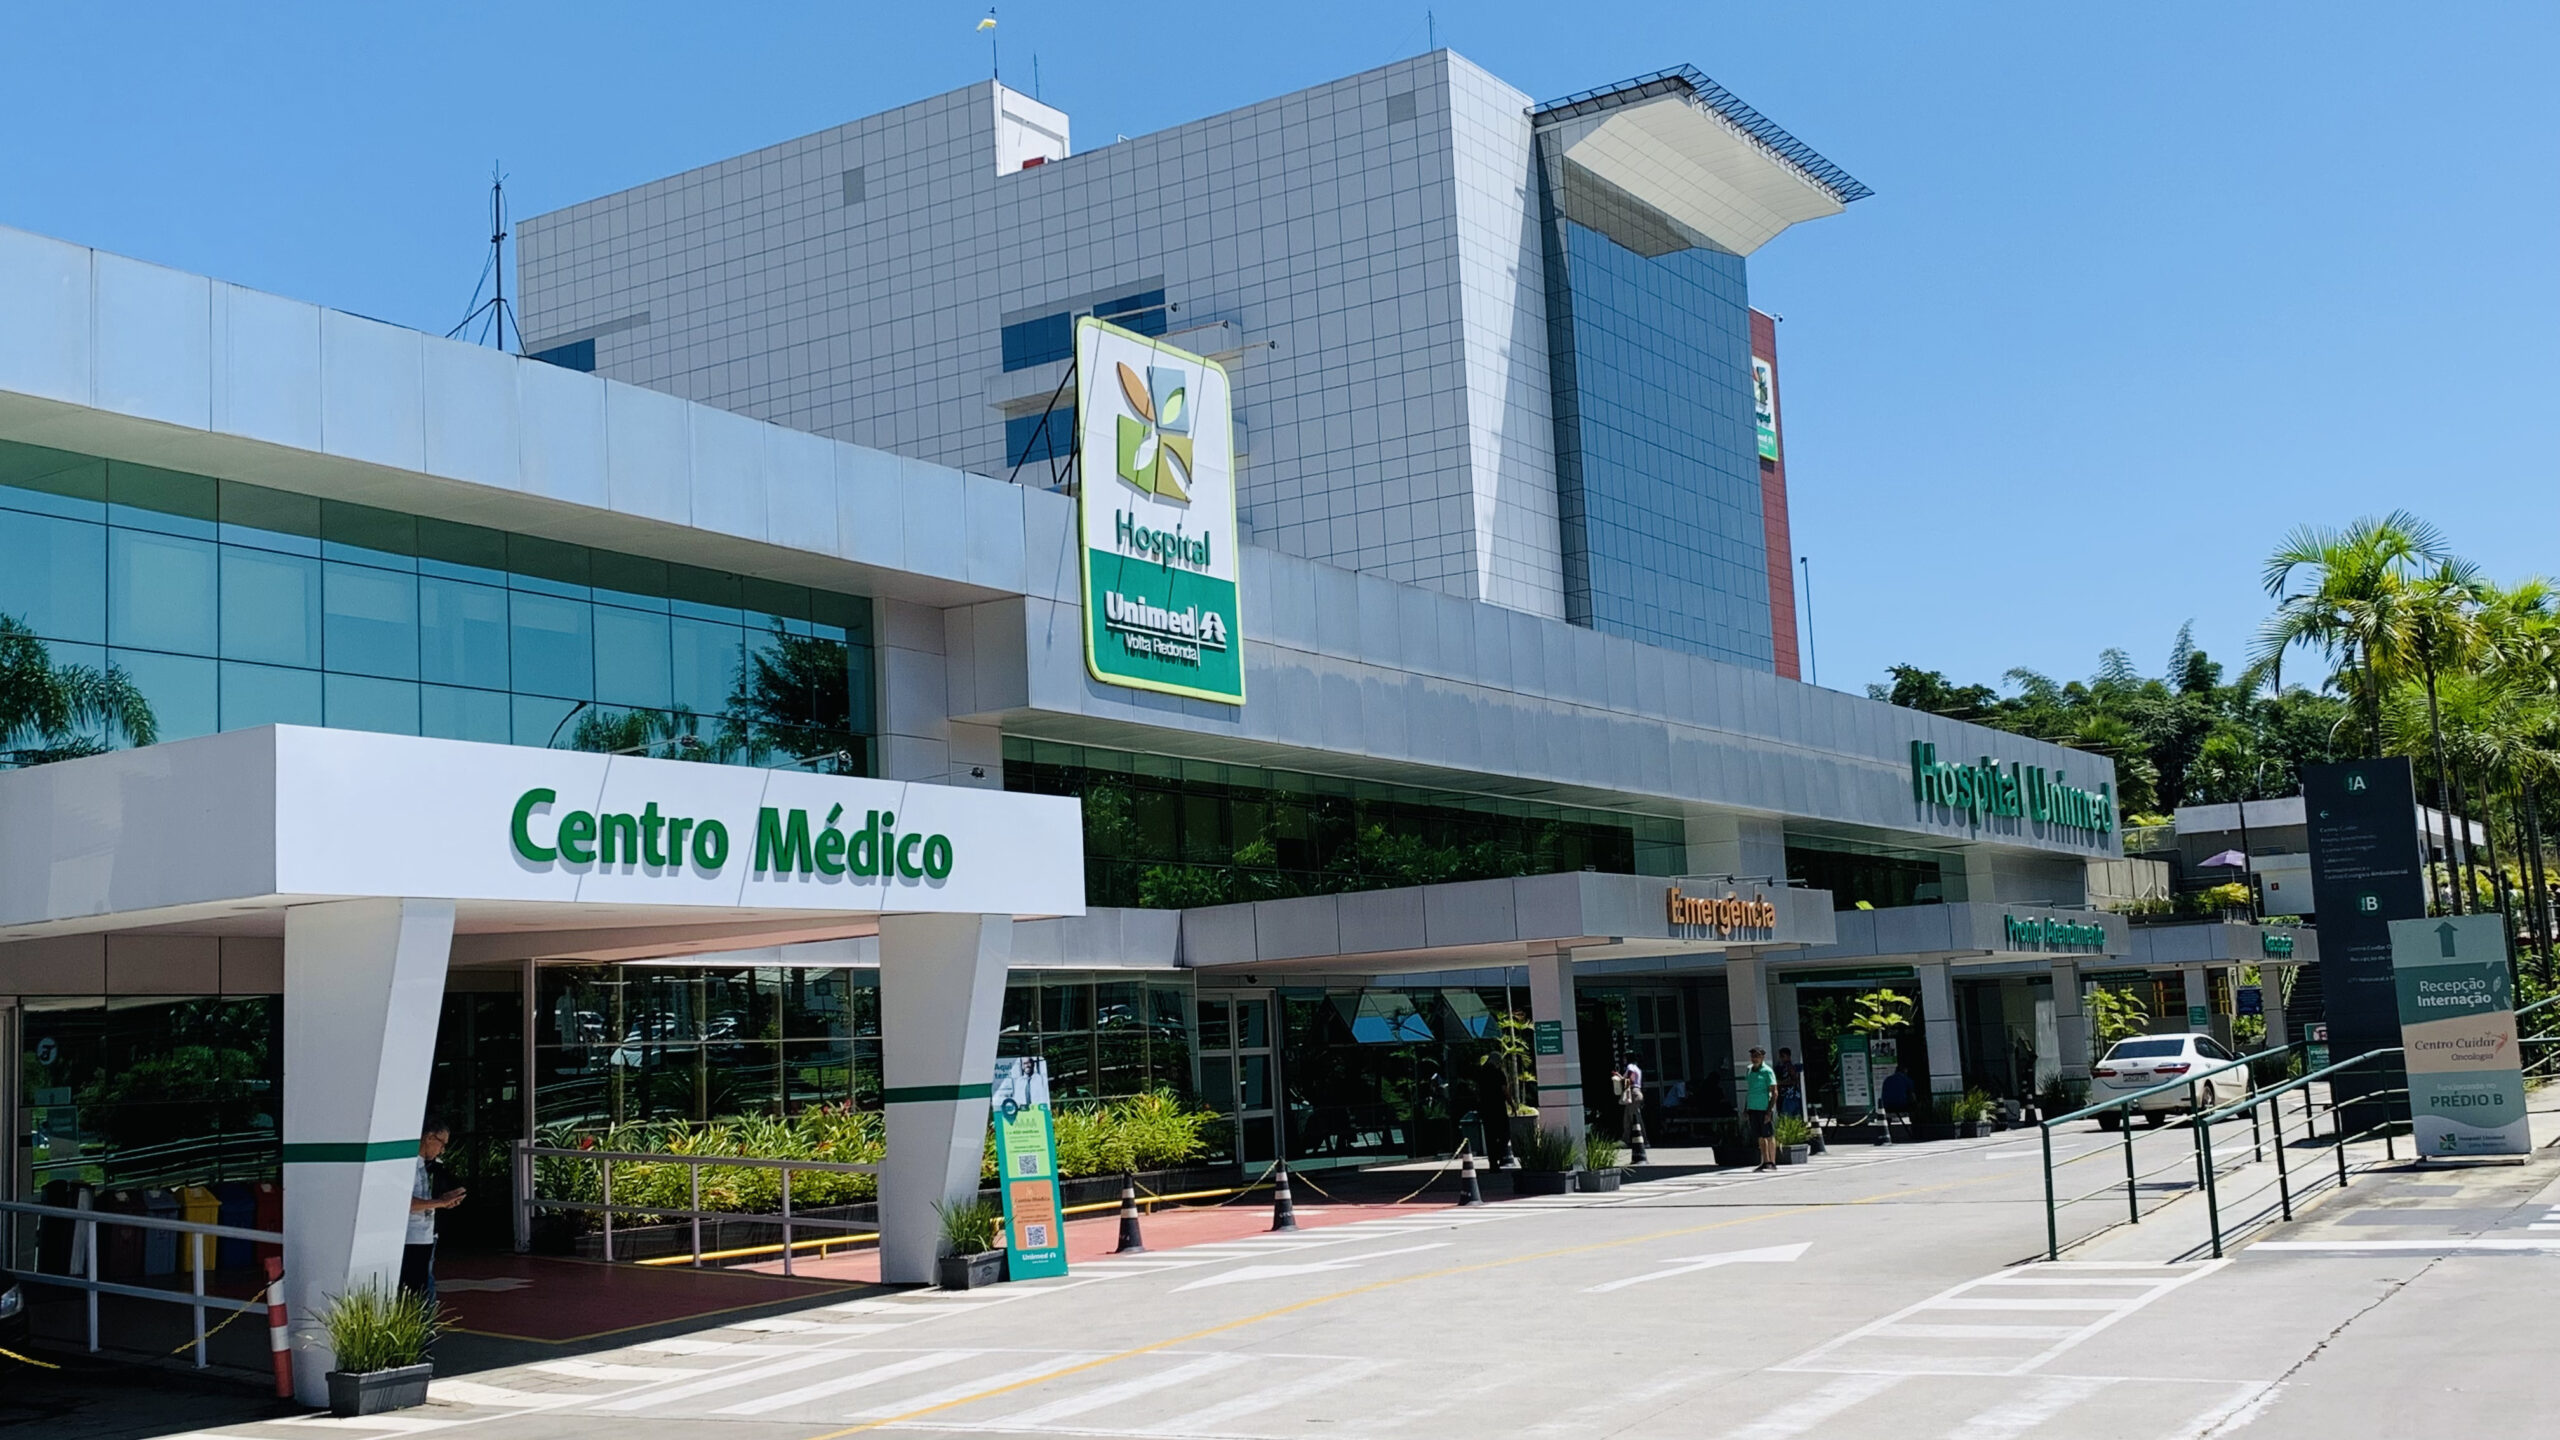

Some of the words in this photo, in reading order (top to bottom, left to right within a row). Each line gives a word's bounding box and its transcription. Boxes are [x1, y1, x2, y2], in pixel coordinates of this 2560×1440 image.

[1116, 509, 1210, 573] Hospital
[1105, 591, 1196, 636] Unimed
[1125, 633, 1151, 650] Volta
[1153, 638, 1198, 661] Redonda
[1911, 740, 2025, 824] Hospital
[2026, 765, 2114, 833] Unimed
[2353, 776, 2367, 790] A
[511, 787, 729, 870] Centro
[754, 801, 953, 879] Médico
[1666, 888, 1776, 935] Emergência
[2366, 896, 2378, 911] B
[2004, 914, 2042, 944] Pronto
[2044, 917, 2105, 947] Atendimento
[2420, 978, 2486, 994] Recepção
[2417, 991, 2492, 1008] Internação
[2415, 1040, 2453, 1051] Centro
[2456, 1036, 2496, 1049] Cuidar
[2451, 1052, 2494, 1062] Oncologia
[2430, 1091, 2489, 1107] PRÉDIO
[2493, 1094, 2504, 1106] B
